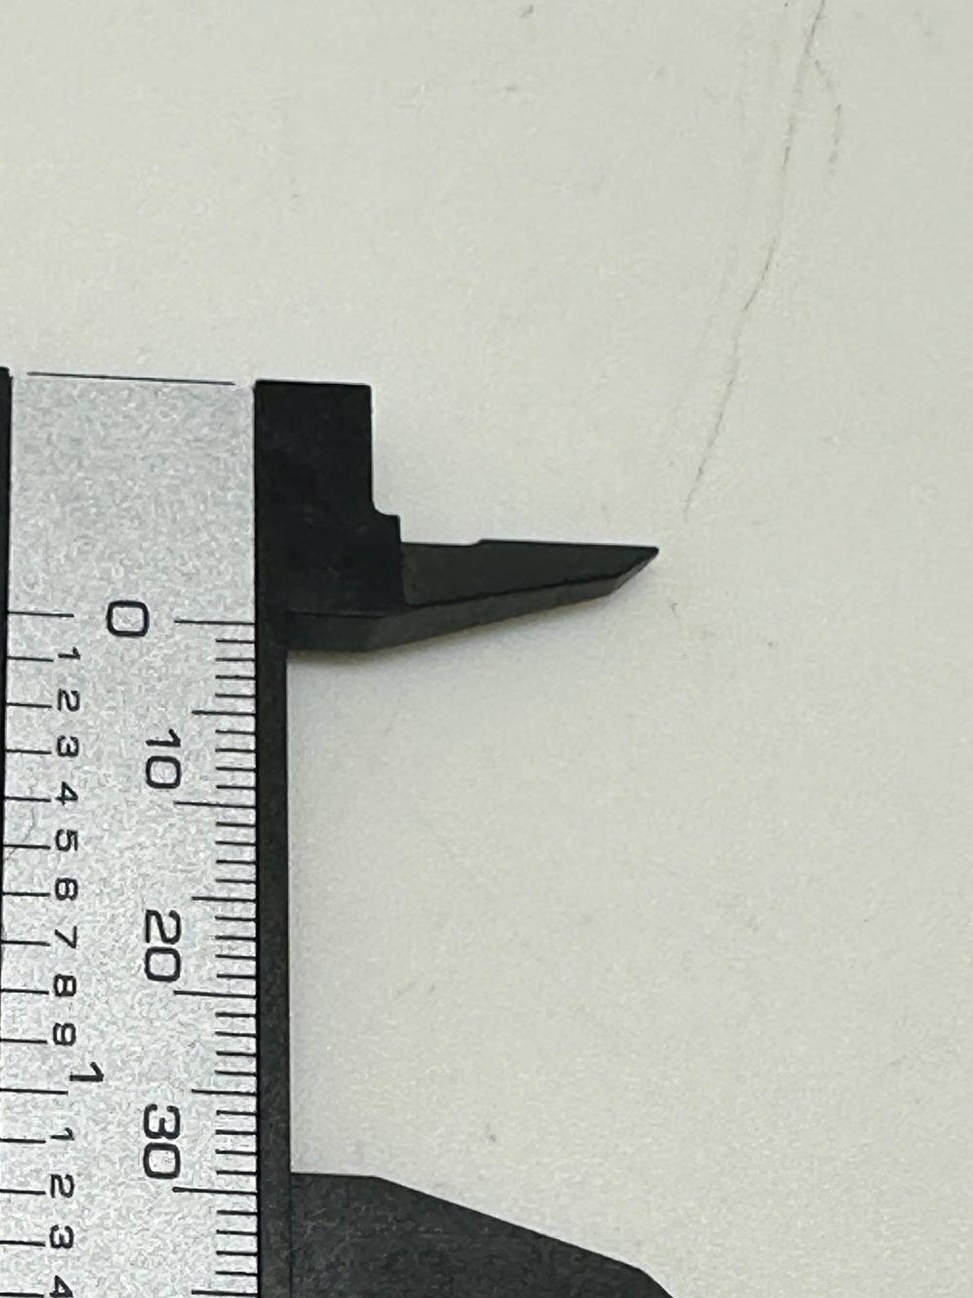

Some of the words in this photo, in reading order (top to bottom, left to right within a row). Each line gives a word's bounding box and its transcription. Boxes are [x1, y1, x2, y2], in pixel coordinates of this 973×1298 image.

[106, 600, 150, 637] 0
[57, 647, 81, 662] 1
[57, 690, 81, 712] 2
[56, 736, 79, 757] 3
[144, 728, 181, 789] 10
[55, 781, 79, 806] 4
[54, 829, 78, 851] 5
[54, 926, 77, 949] 7
[144, 909, 181, 982] 20
[53, 974, 77, 997] 8
[69, 1062, 104, 1082] 1
[50, 1127, 74, 1141] 1
[143, 1103, 181, 1180] 30
[50, 1174, 74, 1199] 2
[49, 1225, 74, 1250] 3
